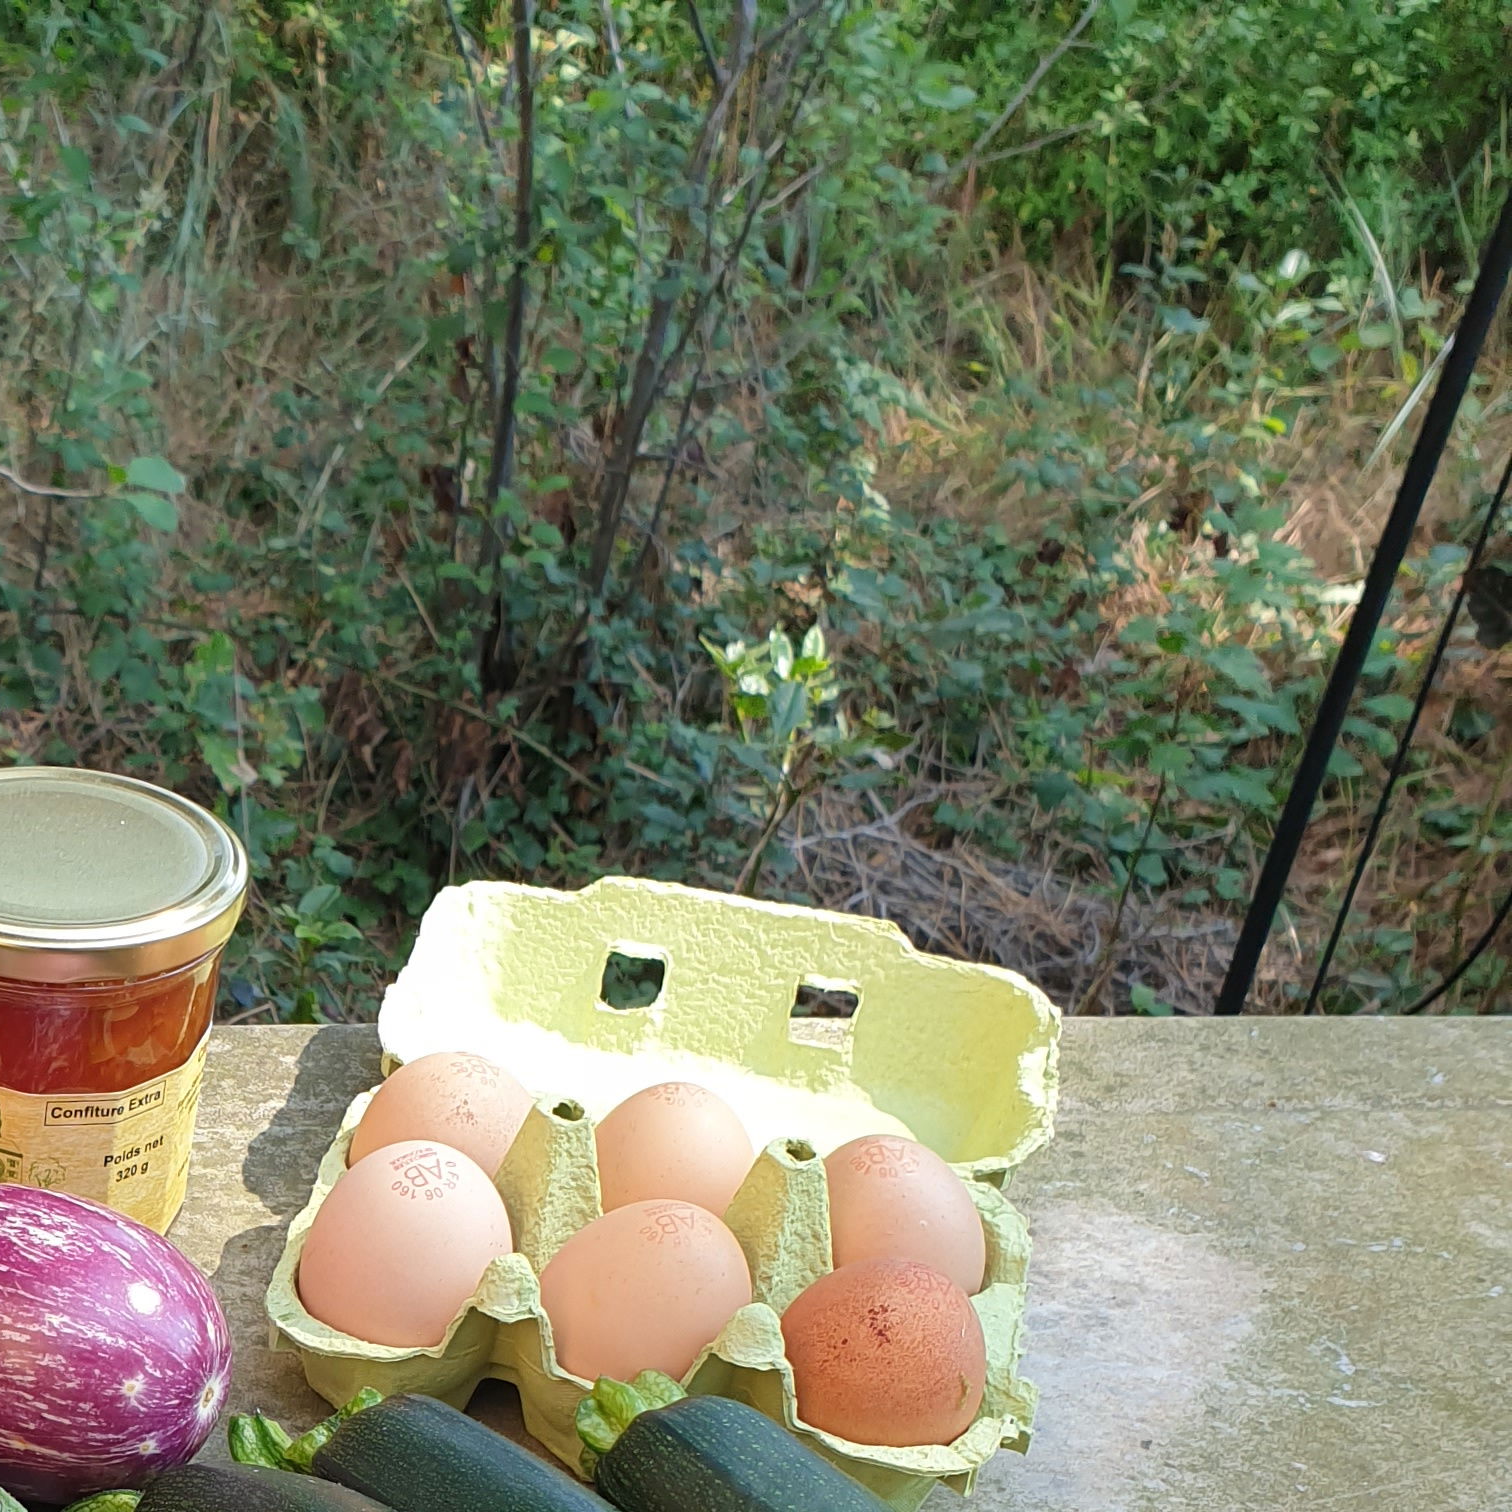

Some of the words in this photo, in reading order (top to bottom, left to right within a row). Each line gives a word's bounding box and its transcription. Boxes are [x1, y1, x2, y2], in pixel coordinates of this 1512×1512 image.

[50, 1105, 125, 1119] Confiture
[128, 1089, 161, 1112] Extra
[103, 1146, 141, 1168] Poids
[144, 1135, 164, 1153] net
[115, 1164, 138, 1182] 320
[140, 1161, 149, 1175] g
[404, 1158, 443, 1188] AB
[391, 1180, 416, 1200] 160
[424, 1187, 444, 1201] 06
[655, 1211, 695, 1234] AB
